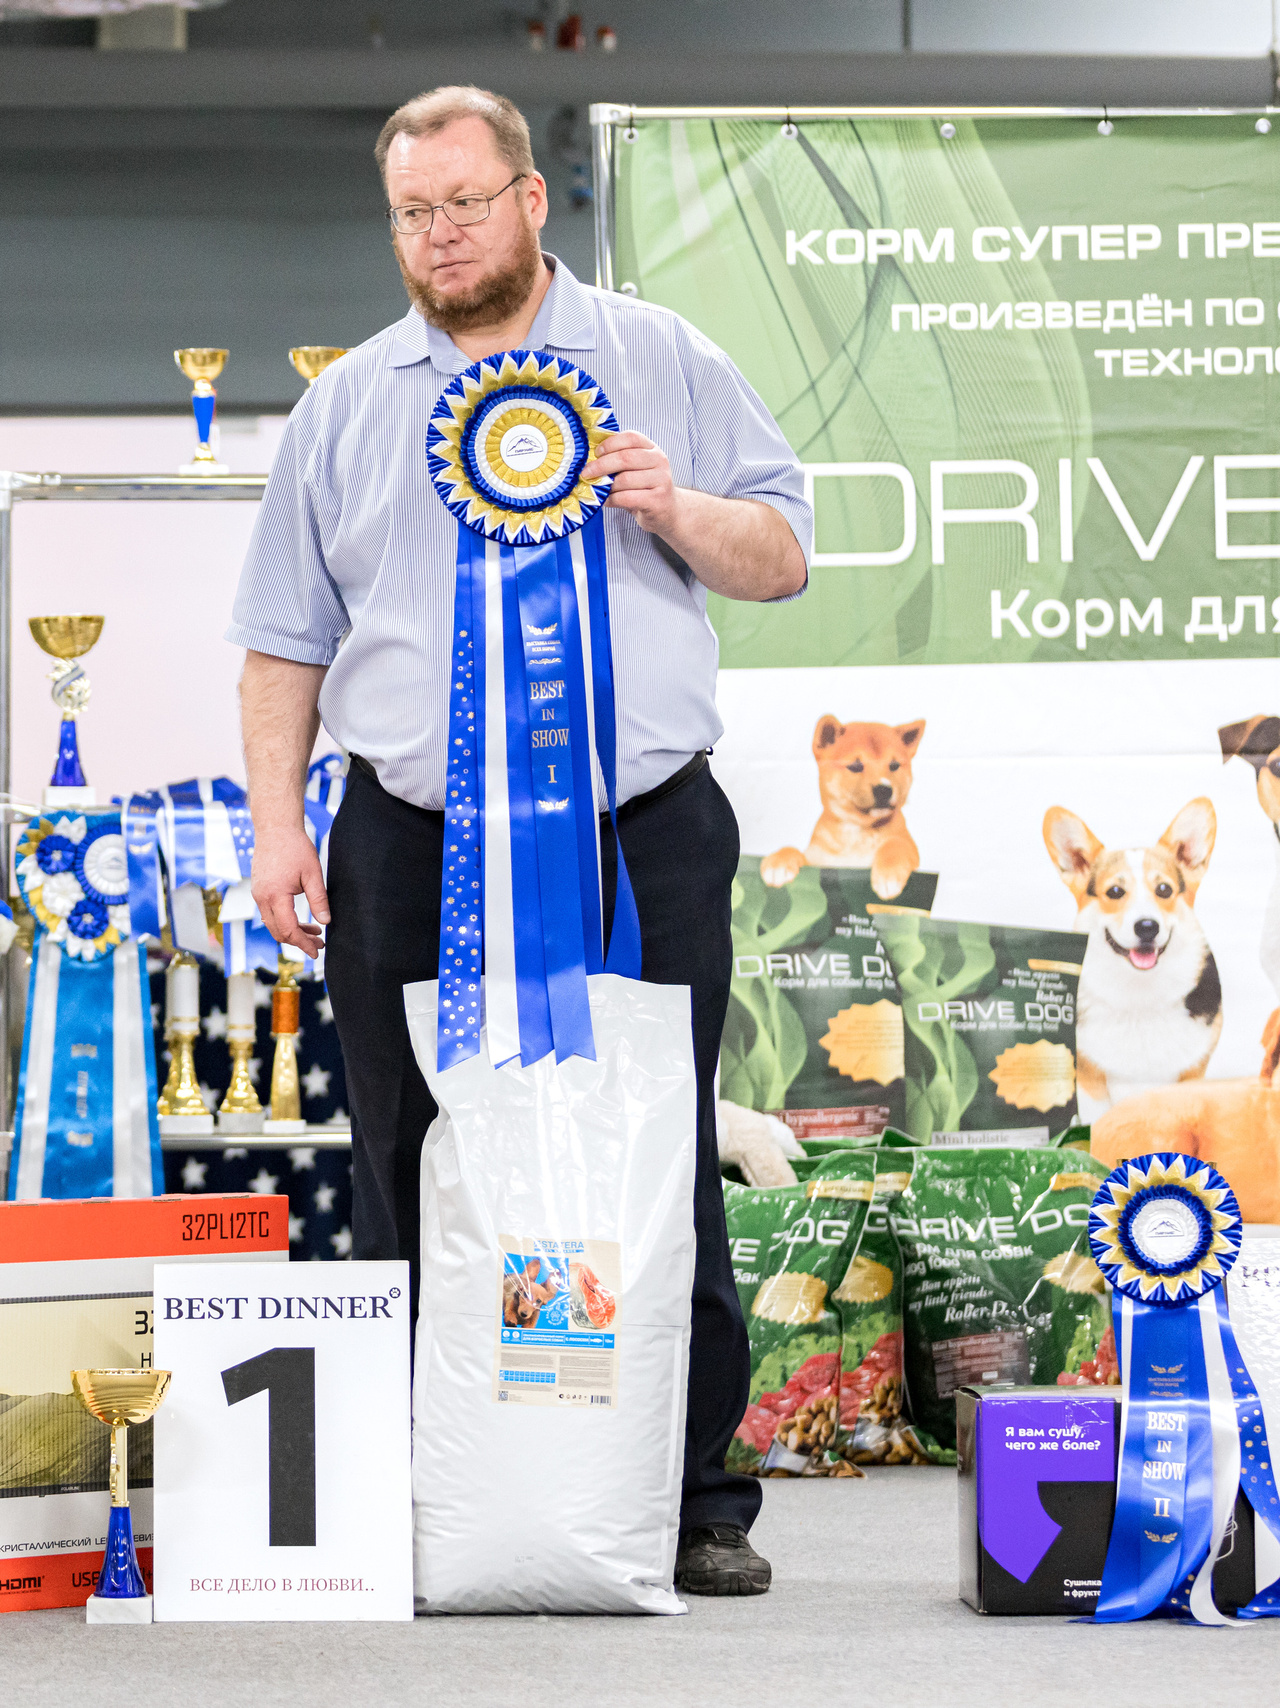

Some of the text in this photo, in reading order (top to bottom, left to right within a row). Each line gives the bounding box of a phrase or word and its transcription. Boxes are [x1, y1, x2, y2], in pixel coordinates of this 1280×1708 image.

[785, 226, 956, 265] КОРМ
[971, 224, 1162, 262] СУПЕР
[891, 294, 1193, 333] ПРОИЗВЕДЁН
[1205, 297, 1265, 327] ПО
[1094, 346, 1280, 377] ТЕХНОЛ
[802, 453, 1280, 567] DRIVE
[990, 588, 1163, 650] Корм
[529, 680, 565, 700] BEST
[541, 708, 555, 721] IN
[531, 728, 569, 748] SHOW
[547, 765, 558, 783] I
[734, 953, 851, 978] DRIVE
[917, 1001, 1074, 1024] DRIVE DOG
[935, 1131, 1010, 1145] Mini holistic
[181, 1210, 270, 1242] 32PL12TC
[890, 1215, 1017, 1242] DRIVE
[1031, 1203, 1091, 1235] DO
[928, 1254, 960, 1270] food
[945, 1247, 976, 1260] для
[981, 1244, 1034, 1261] собак
[163, 1295, 393, 1320] BEST DINNER
[924, 1292, 949, 1307] little
[1147, 1411, 1186, 1432] BEST
[1005, 1426, 1085, 1440] Я вам сушу,
[220, 1346, 316, 1547] 1
[1005, 1440, 1101, 1451] чего же боле?
[1157, 1440, 1171, 1453] IN
[1142, 1461, 1185, 1481] SHOW
[1153, 1497, 1170, 1517] II
[190, 1578, 223, 1592] ВСЕ
[227, 1578, 276, 1594] ДЕЛО
[282, 1578, 292, 1592] В
